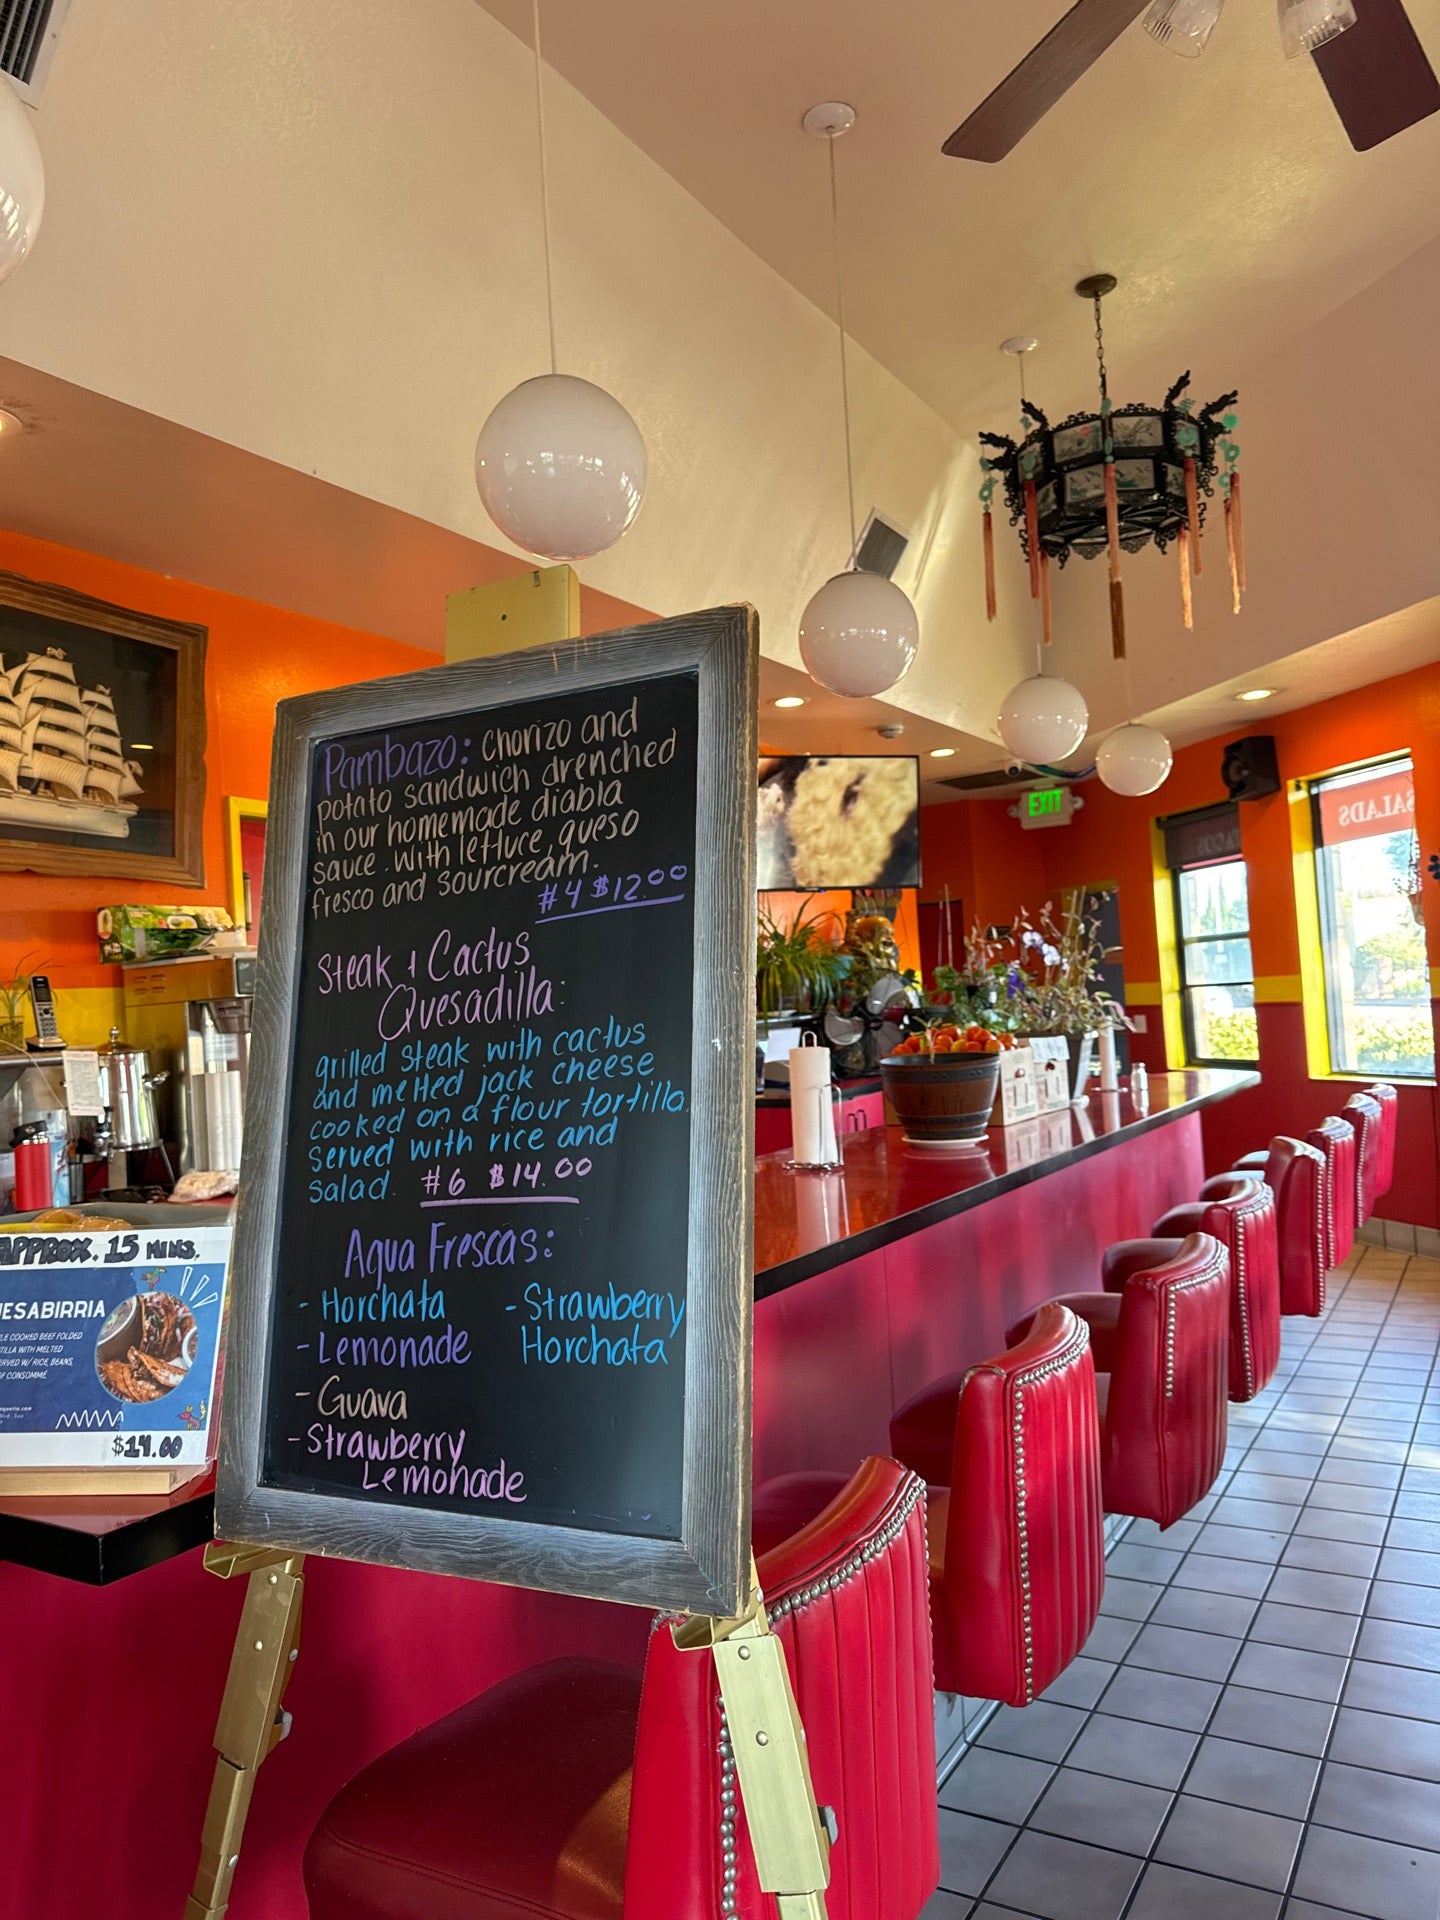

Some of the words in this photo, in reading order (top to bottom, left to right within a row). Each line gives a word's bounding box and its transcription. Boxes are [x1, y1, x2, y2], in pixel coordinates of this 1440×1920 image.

[325, 735, 472, 796] Pambazo:
[580, 696, 638, 744] and
[317, 790, 392, 834] potato
[404, 764, 530, 809] sandwich
[541, 727, 676, 786] drenched
[1028, 788, 1063, 817] EXIT
[316, 829, 335, 855] in
[343, 823, 380, 852] our
[387, 794, 522, 847] homemade
[531, 779, 624, 823] diabla
[558, 808, 640, 855] queso
[311, 887, 374, 920] fresco
[382, 872, 427, 908] and
[427, 926, 530, 982] Cactus
[315, 1041, 387, 1090] grilled
[487, 1027, 542, 1062] with
[552, 1014, 646, 1056] cactus
[313, 1078, 358, 1110] and
[371, 1068, 464, 1108] melted
[476, 1063, 534, 1106] jack
[552, 1051, 655, 1085] cheese
[310, 1107, 405, 1140] cooked
[416, 1107, 451, 1128] on
[461, 1103, 479, 1122] a
[491, 1093, 570, 1124] flour
[410, 1128, 473, 1162] with
[489, 1125, 545, 1153] rice
[557, 1116, 618, 1148] and
[104, 1235, 139, 1263] 15
[146, 1240, 200, 1259] MINS.
[344, 1228, 415, 1291] Agua
[429, 1222, 555, 1273] Frescas:
[0, 1300, 106, 1319] ESABIRRIA
[321, 1278, 446, 1323] Horchata
[523, 1281, 685, 1338] Strawberry
[0, 1346, 17, 1354] TILLA
[36, 1345, 64, 1353] MELTED
[9, 1332, 39, 1341] COOKED
[39, 1332, 57, 1340] BEEF
[56, 1331, 83, 1340] FOLDED
[318, 1324, 472, 1367] Lemonade
[521, 1323, 669, 1365] Horchata
[317, 1375, 408, 1420] Guava
[112, 1434, 183, 1459] $14.00
[363, 1459, 527, 1502] Lemonade
